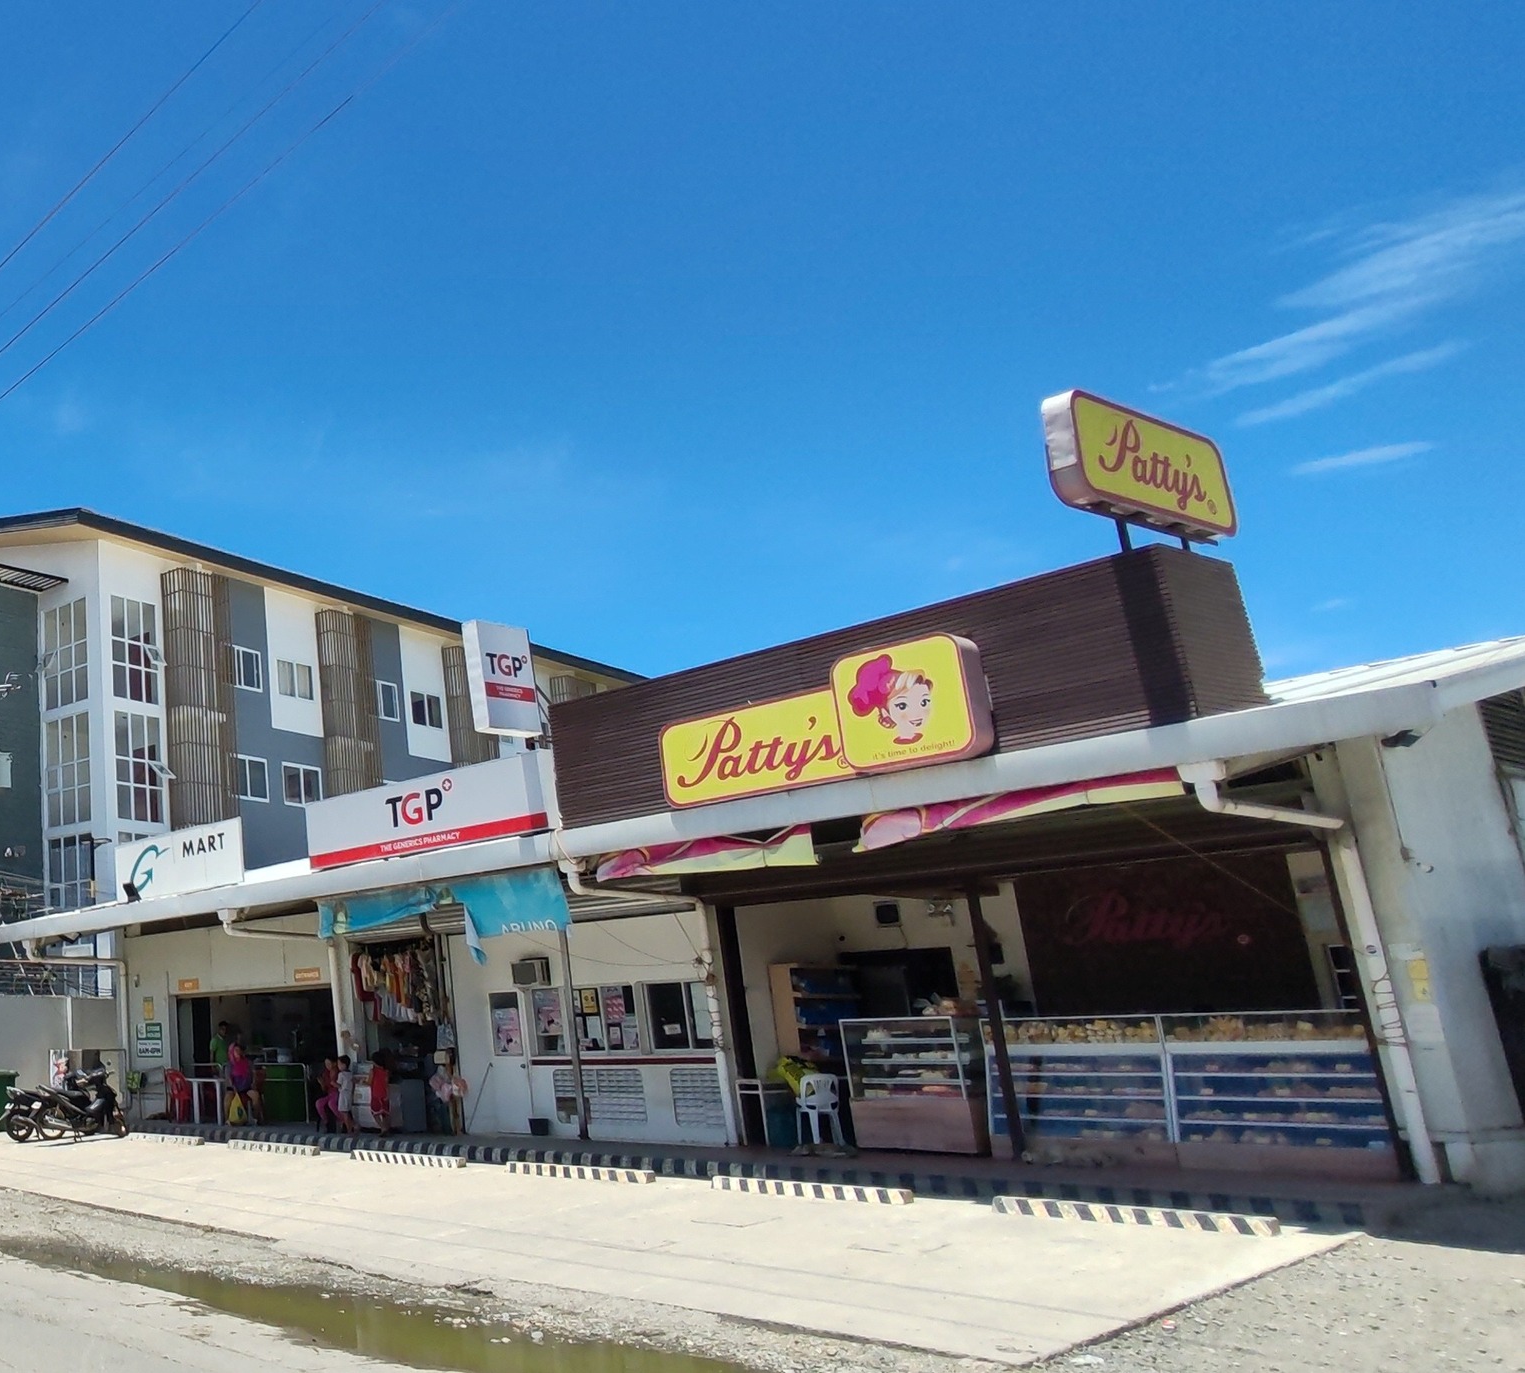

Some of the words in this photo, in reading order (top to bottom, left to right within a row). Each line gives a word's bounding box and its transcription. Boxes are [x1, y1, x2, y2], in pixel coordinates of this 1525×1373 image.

[1098, 419, 1206, 511] Patty's
[485, 652, 523, 678] TGP
[677, 716, 841, 788] Patty's
[887, 749, 907, 758] time
[385, 787, 443, 828] TGP
[182, 832, 225, 858] MART
[380, 844, 393, 852] THE
[392, 838, 423, 850] GENERICS
[423, 831, 461, 844] PHARMACY
